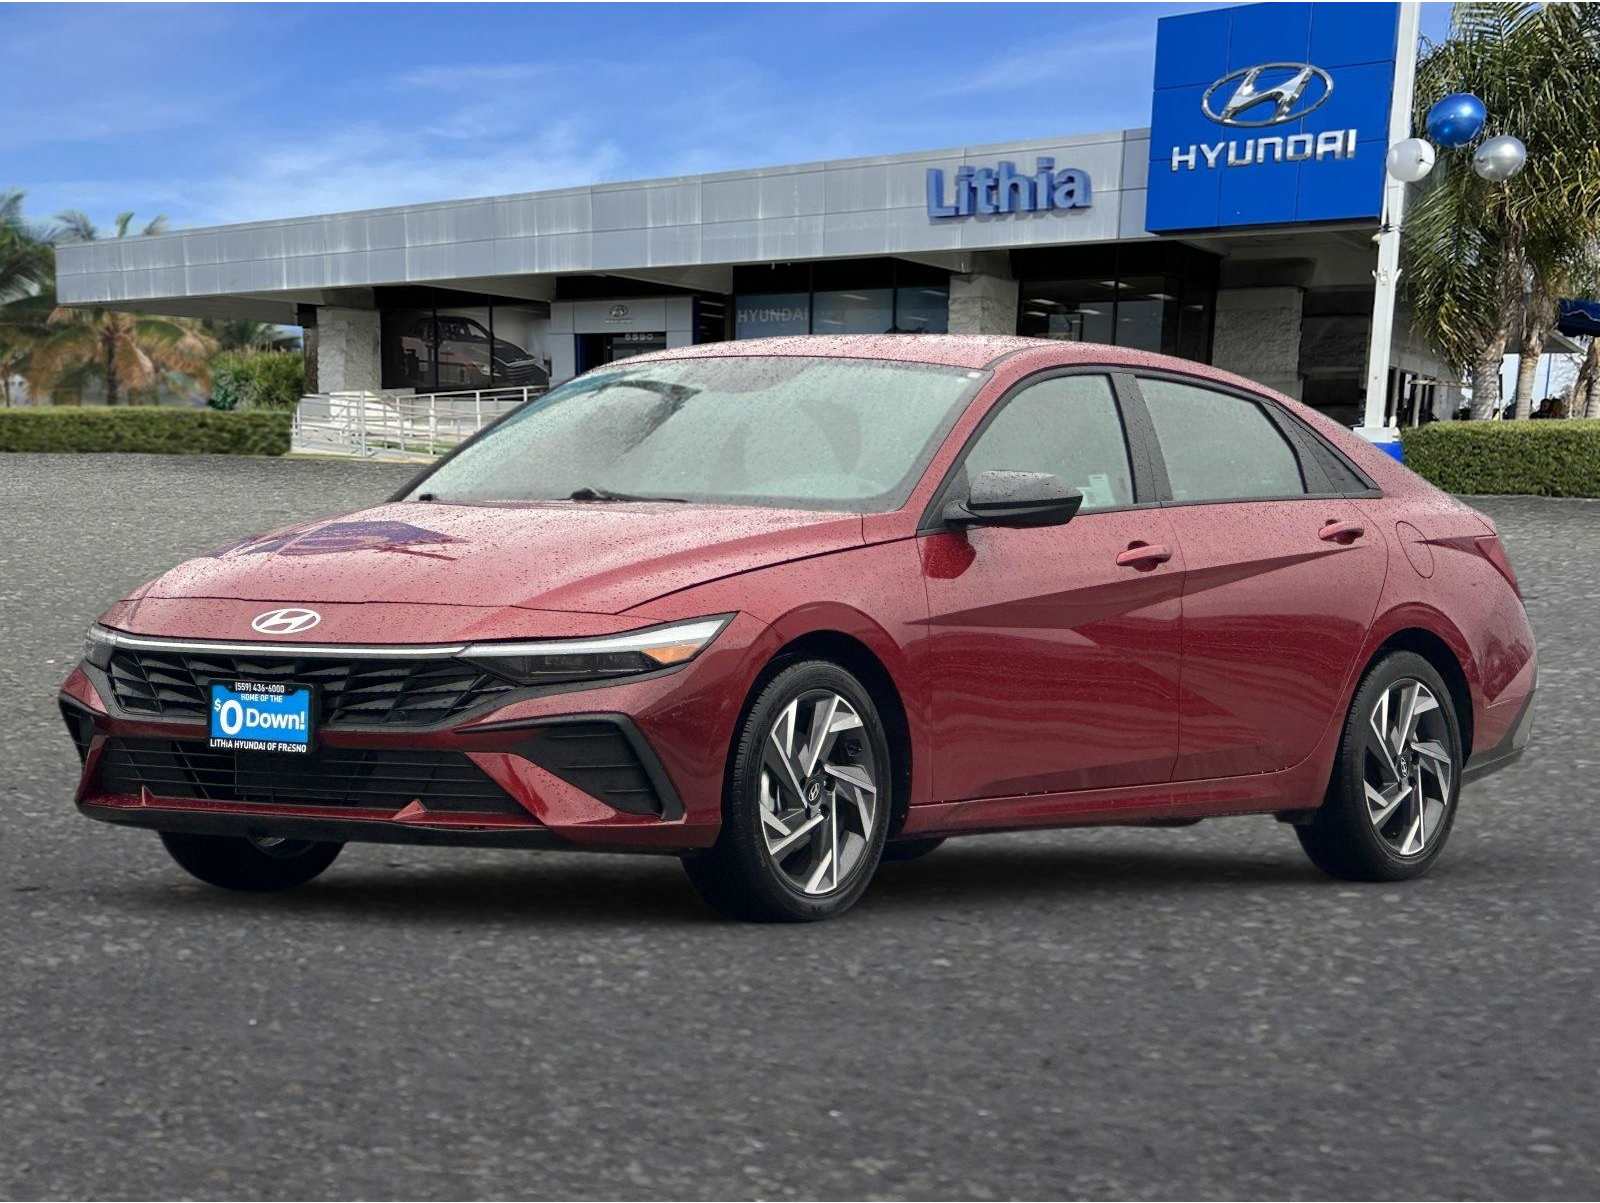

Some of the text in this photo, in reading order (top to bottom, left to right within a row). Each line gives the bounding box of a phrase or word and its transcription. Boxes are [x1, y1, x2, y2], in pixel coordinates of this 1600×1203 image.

[1171, 128, 1358, 171] HYUNDAI
[926, 157, 1092, 218] Lithia
[737, 308, 809, 322] HYUNDAI
[253, 683, 285, 693] 436-6000
[260, 694, 269, 702] OF
[270, 695, 283, 703] THE
[246, 708, 305, 730] Down!
[234, 740, 266, 750] HYUNDAI
[267, 742, 277, 751] OF
